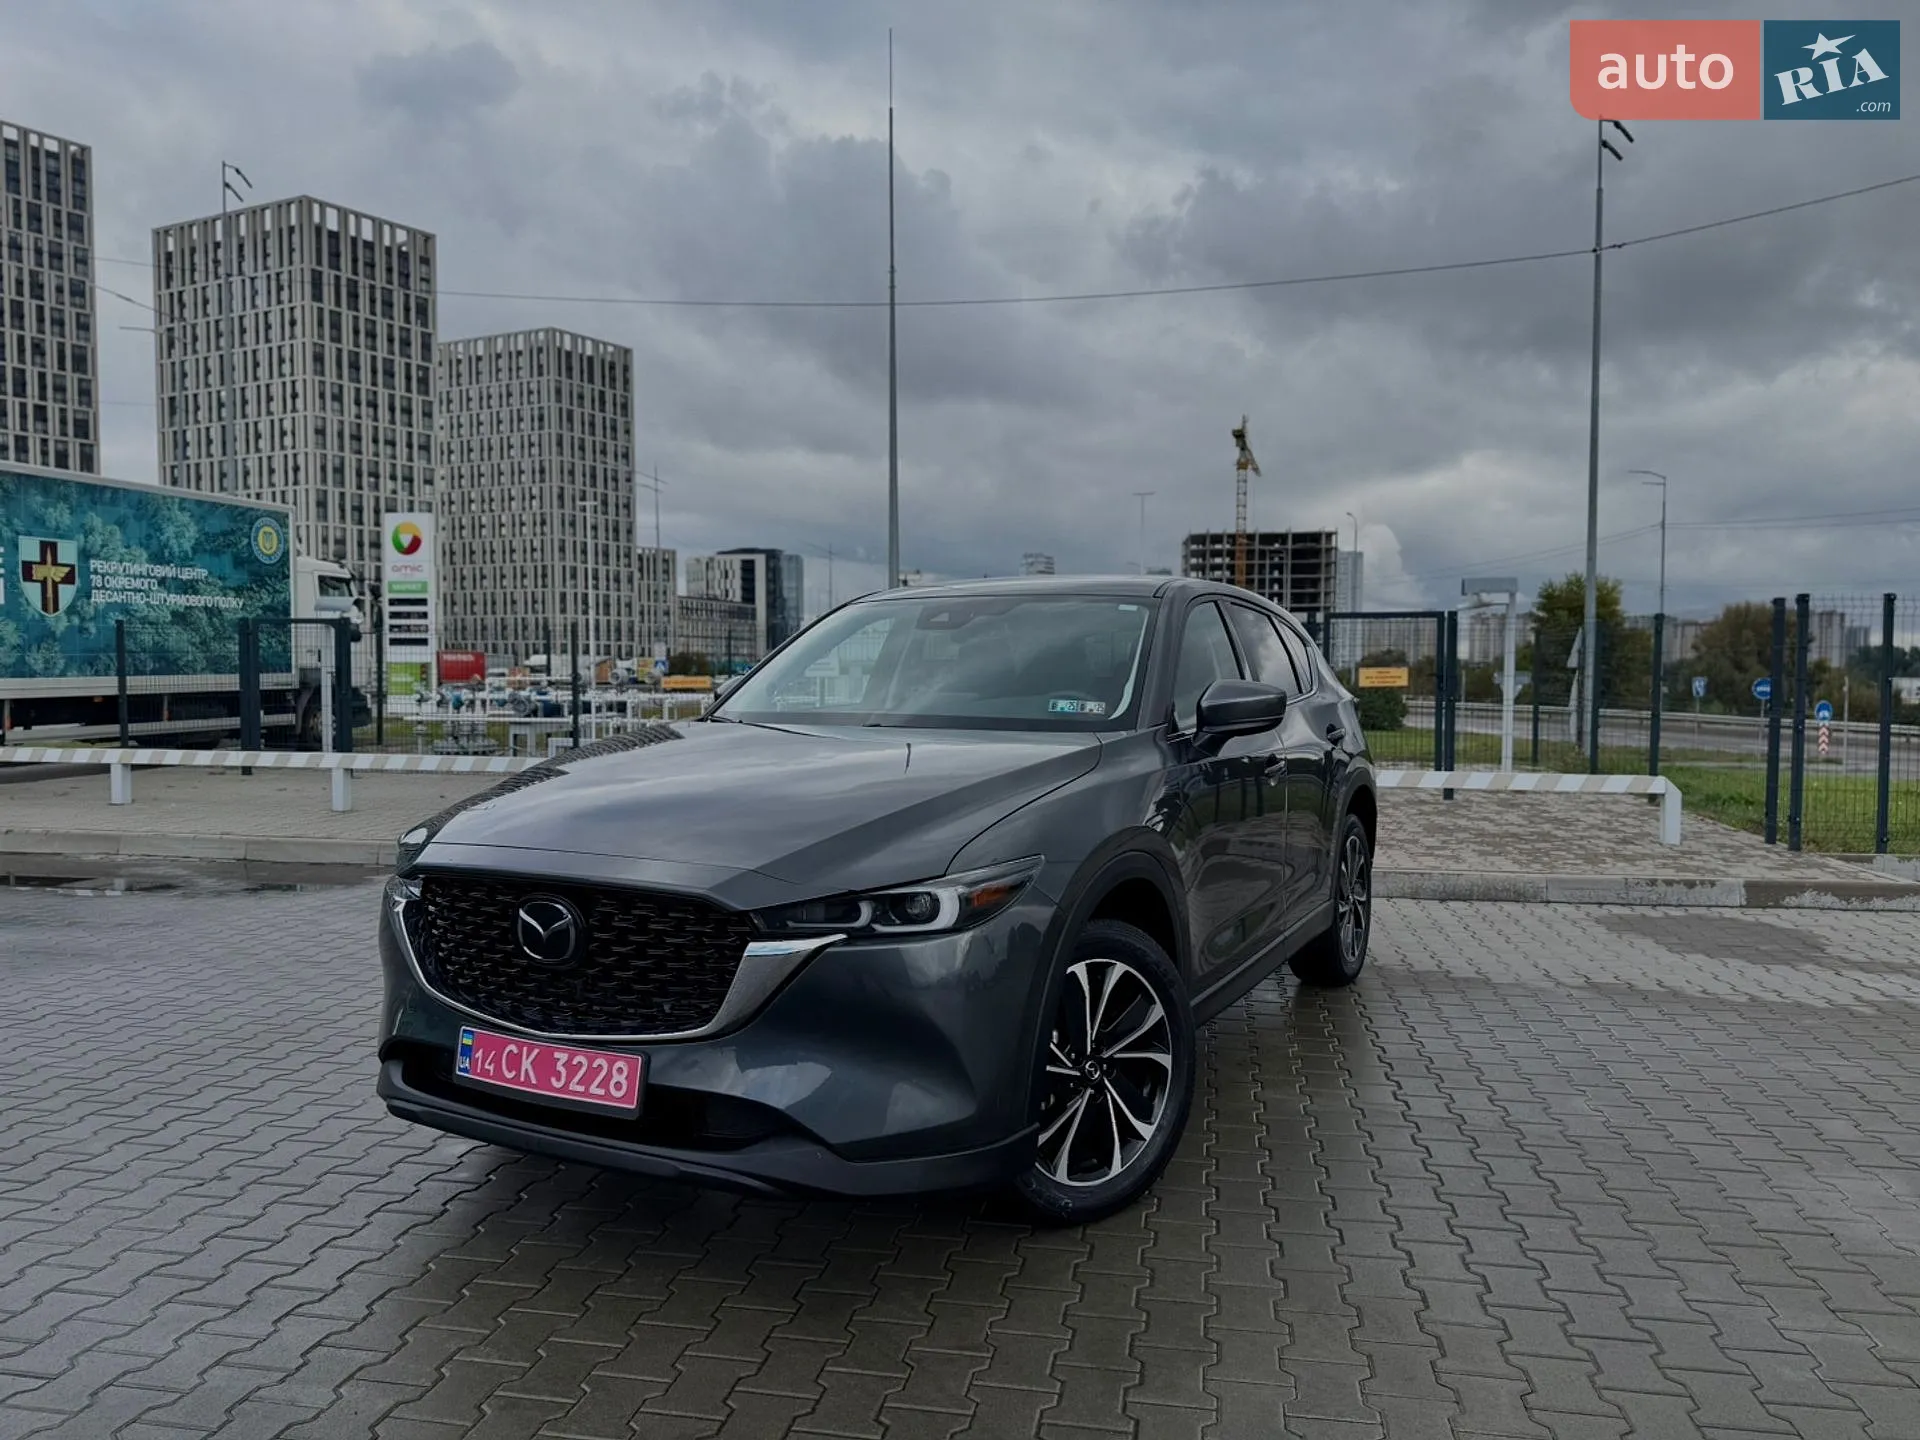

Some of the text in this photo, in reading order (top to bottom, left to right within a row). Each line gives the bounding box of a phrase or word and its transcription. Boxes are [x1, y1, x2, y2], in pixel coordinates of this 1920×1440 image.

[90, 560, 208, 580] РЕКРУТИНГОВИЙ ЦЕНТР
[90, 575, 158, 590] 78 ОКРЕМОГО
[91, 590, 244, 608] ДЕСАНТНО-ШТУРМОВОГО ПОЛКУ
[459, 1056, 471, 1071] UA
[550, 1051, 629, 1098] 3228
